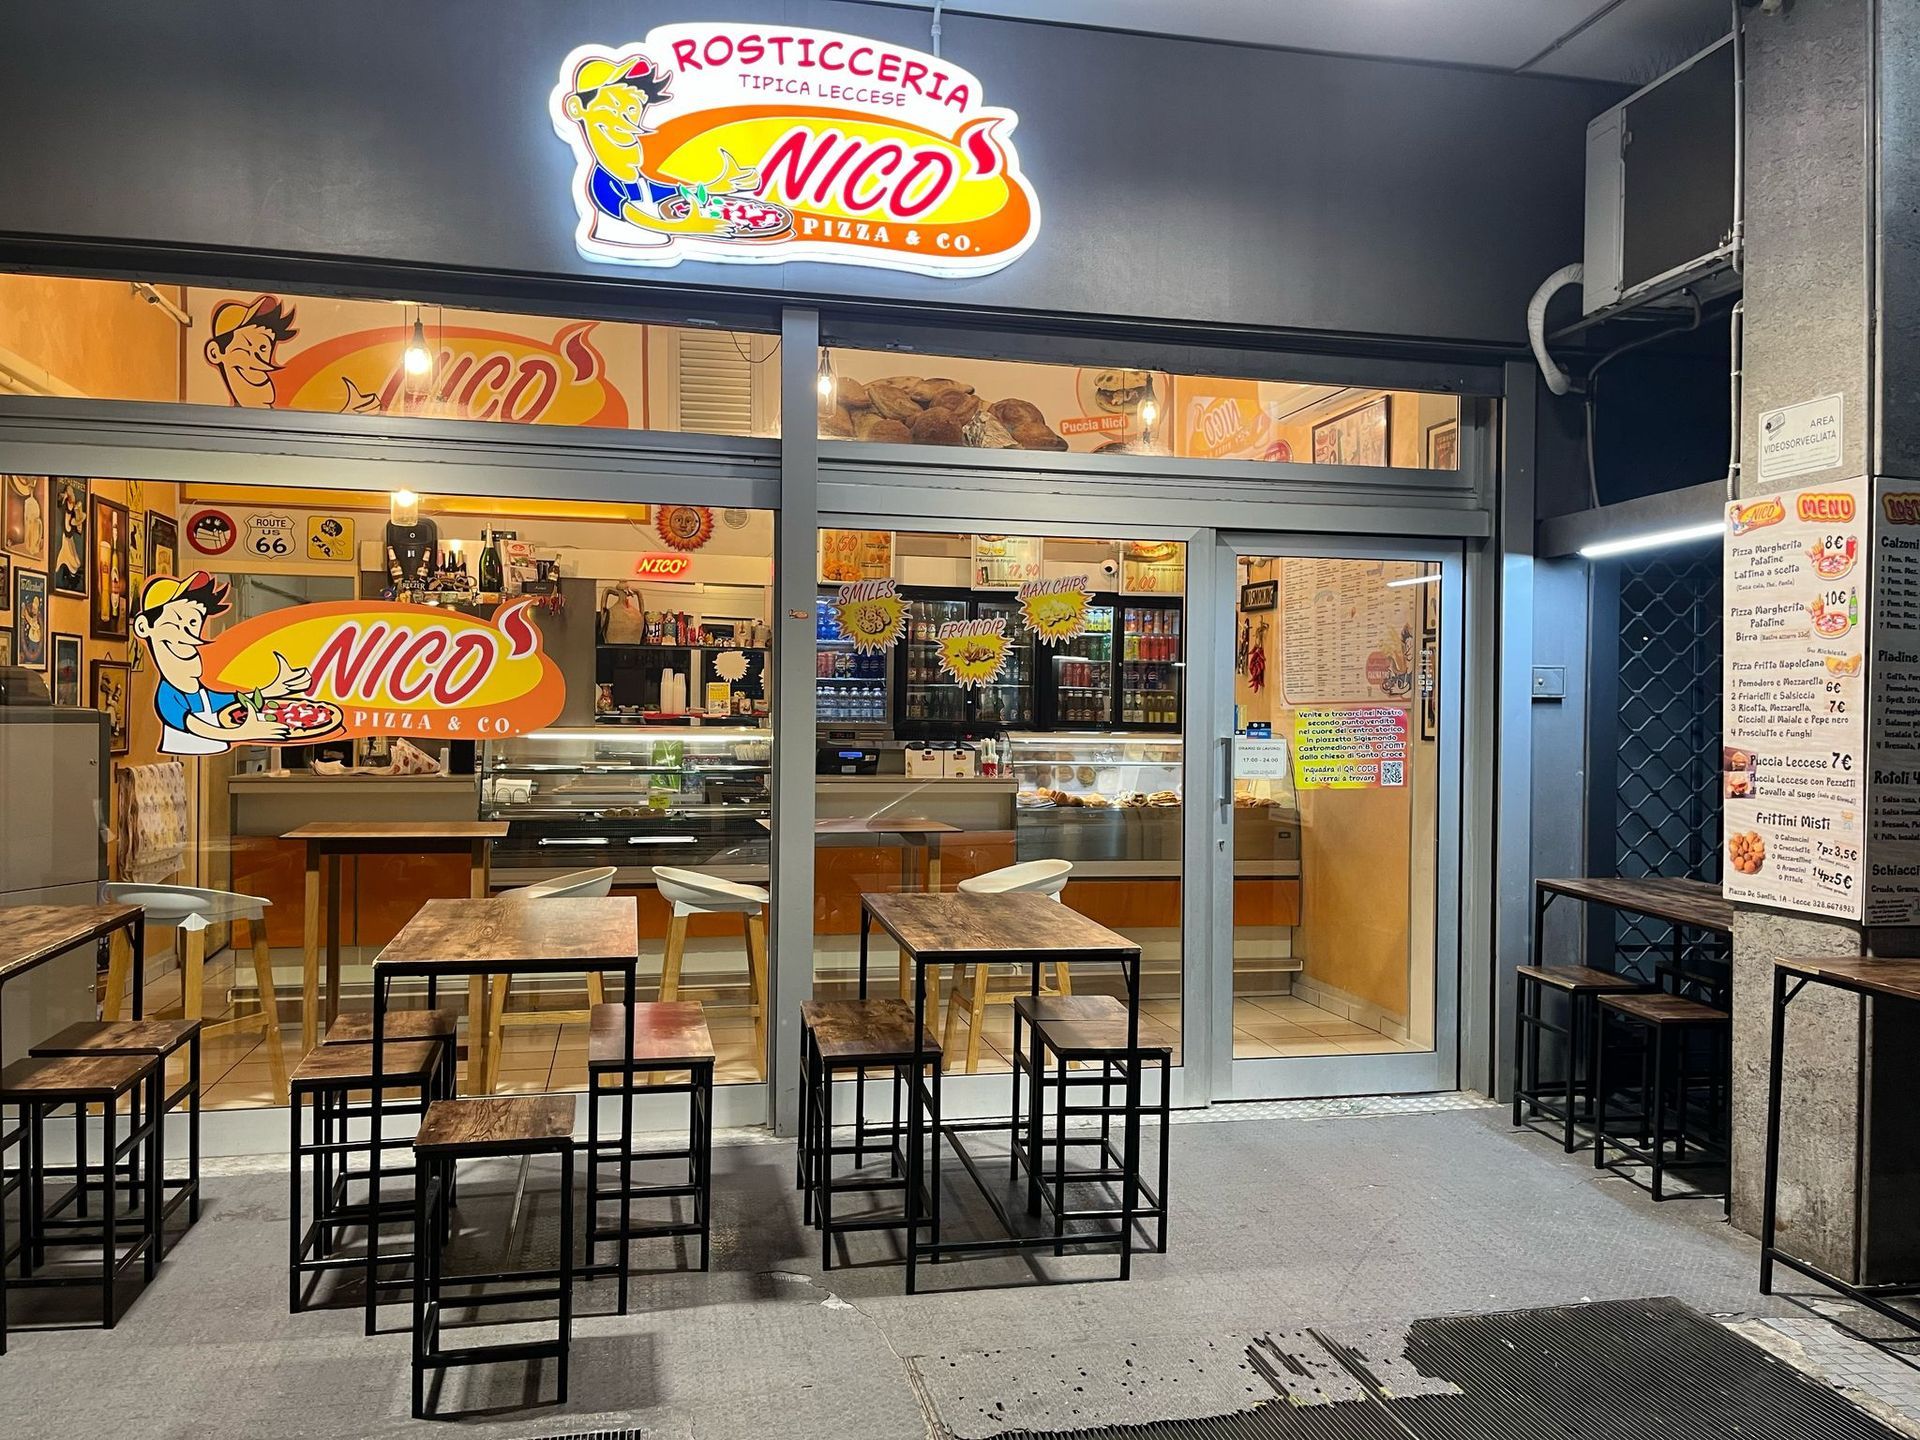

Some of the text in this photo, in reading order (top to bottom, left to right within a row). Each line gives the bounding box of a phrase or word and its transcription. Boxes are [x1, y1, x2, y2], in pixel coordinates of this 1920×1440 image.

[672, 35, 970, 113] ROSTICCERIA
[739, 74, 907, 107] TIPICA LECCESE
[803, 217, 981, 253] PIZZA & CO.
[1062, 419, 1099, 434] Puccia
[1810, 415, 1835, 428] AREA
[1764, 430, 1837, 454] VIDEOSORVEGLIATA
[1802, 499, 1851, 516] MENU
[256, 519, 287, 528] ROUTE
[256, 537, 288, 554] 66
[1732, 535, 1843, 557] Pizza Margherita 8€
[1881, 536, 1920, 550] Calzoni
[1751, 555, 1783, 566] Patatine
[1734, 569, 1764, 579] Lattina
[1774, 565, 1800, 574] scelta
[839, 580, 896, 606] SMILES
[1020, 577, 1088, 599] MAXI CHIPS
[1825, 591, 1846, 606] 10€
[1731, 602, 1804, 617] Pizza Margherita
[1750, 619, 1785, 628] Patatine
[1736, 632, 1757, 641] Birra
[1878, 650, 1919, 663] Piadine
[1732, 662, 1752, 670] Pizza
[1780, 659, 1824, 670] Napoletana
[1739, 679, 1774, 687] Pomodoro
[1783, 677, 1823, 686] Mozzarella
[1826, 682, 1840, 693] 6€
[1829, 700, 1845, 713] 7€
[354, 711, 521, 736] PIZZA & CO.
[1811, 715, 1829, 725] Pepe
[1739, 729, 1777, 737] Prosciutto
[1786, 729, 1812, 739] Funghi
[1750, 752, 1852, 771] Puccia Leccese 7€
[1750, 774, 1774, 783] Puccia
[1777, 775, 1808, 785] Leccese
[1826, 778, 1856, 788] Pezzetti
[1874, 770, 1910, 784] Rotoli
[1760, 787, 1785, 796] Cavallo
[1788, 788, 1795, 796] al
[1757, 812, 1831, 830] Frittini Misti
[1792, 898, 1810, 906] Lecce
